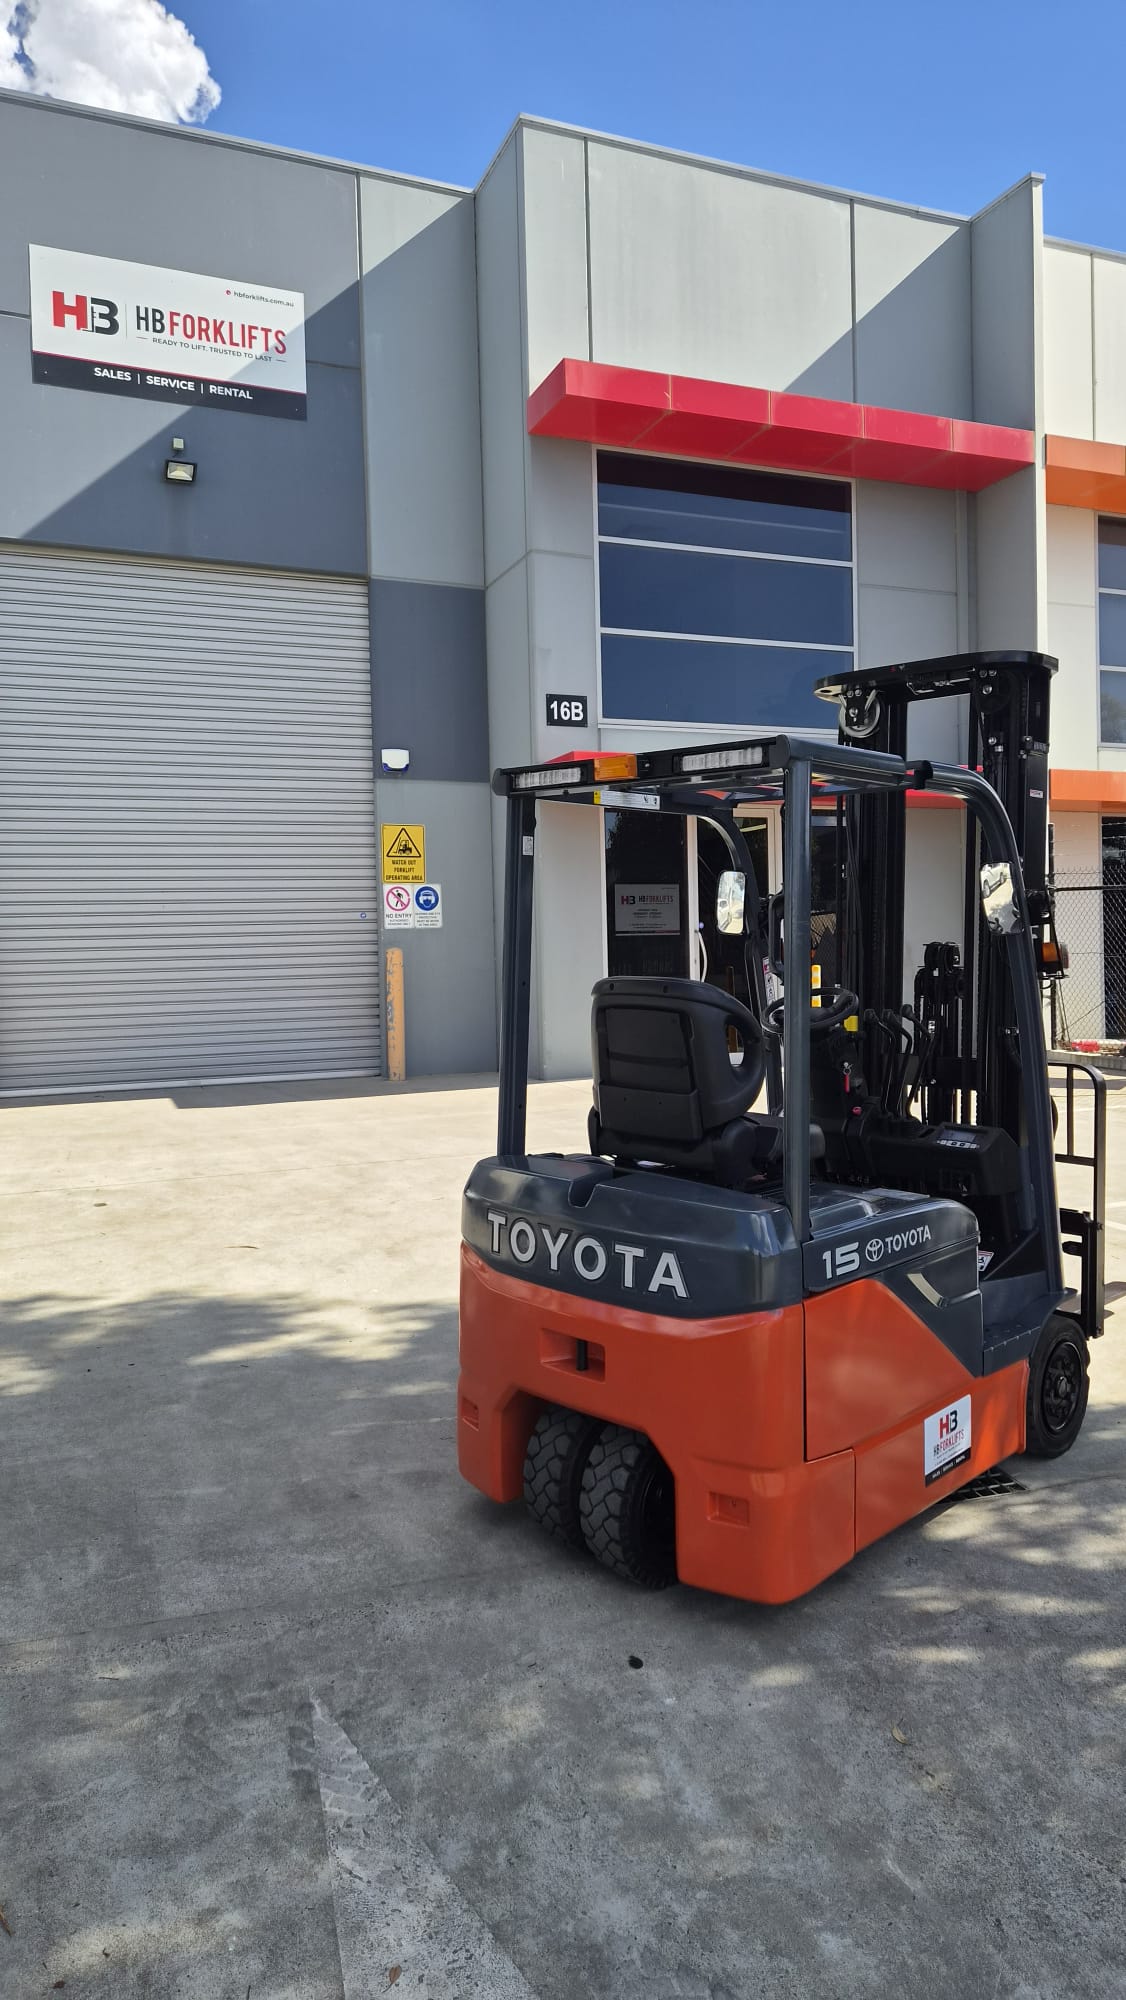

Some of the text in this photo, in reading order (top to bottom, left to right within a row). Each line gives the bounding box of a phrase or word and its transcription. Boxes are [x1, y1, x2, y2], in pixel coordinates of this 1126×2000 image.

[52, 290, 120, 336] HB
[233, 291, 294, 307] hbforklifts.com.au
[152, 337, 178, 347] READY
[179, 341, 190, 349] TO
[210, 346, 242, 358] TRUSTED
[255, 354, 273, 362] LAST
[94, 367, 253, 400] SALES SERVICE RENTAL
[550, 700, 584, 721] 16B
[487, 1211, 689, 1298] TOYOTA
[822, 1224, 932, 1280] 15 TOYOTA
[939, 1409, 959, 1440] HB
